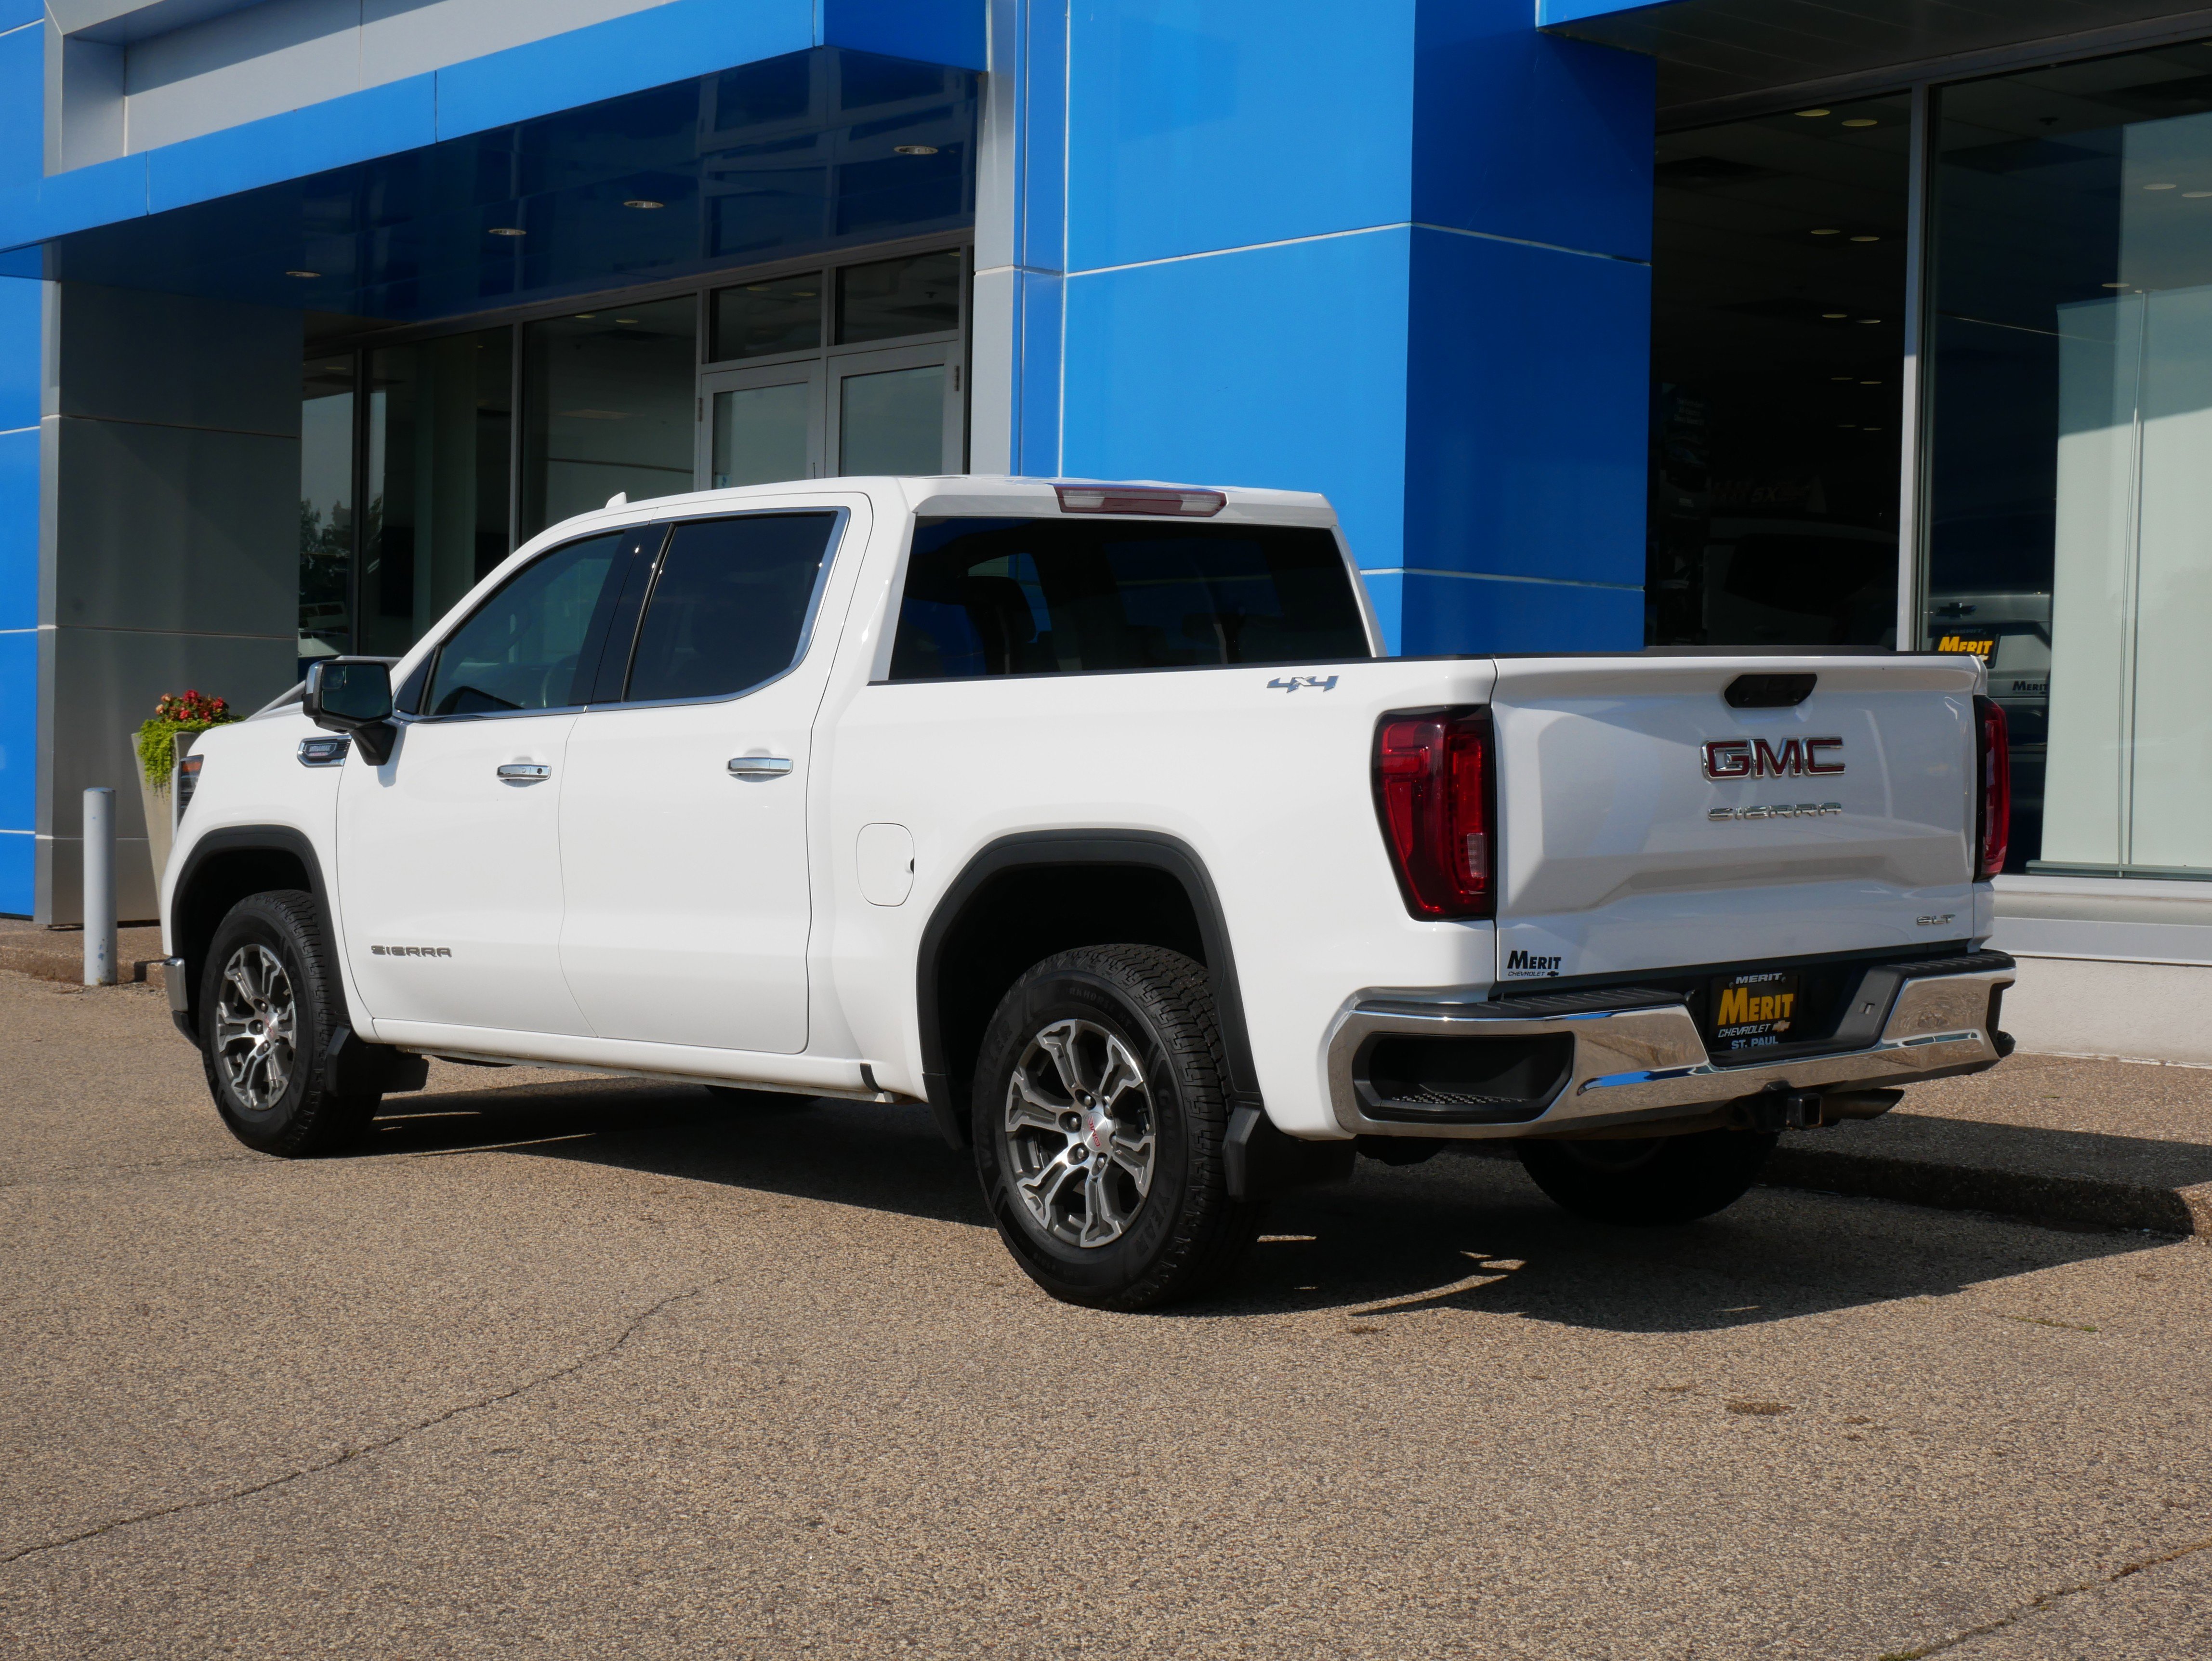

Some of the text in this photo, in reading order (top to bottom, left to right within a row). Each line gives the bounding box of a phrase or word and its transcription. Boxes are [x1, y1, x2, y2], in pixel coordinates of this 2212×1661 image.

[1938, 636, 1993, 654] MERIT
[1701, 736, 1846, 781] GMC
[1708, 802, 1842, 821] SIERRA
[1917, 914, 1956, 925] SLT
[371, 945, 452, 958] SIERRA
[1507, 950, 1562, 970] MERIT
[1735, 972, 1782, 984] MERIT
[1717, 987, 1794, 1026] MERIT
[1718, 1023, 1771, 1038] CHEVROLET
[1731, 1036, 1779, 1050] ST. PAUL
